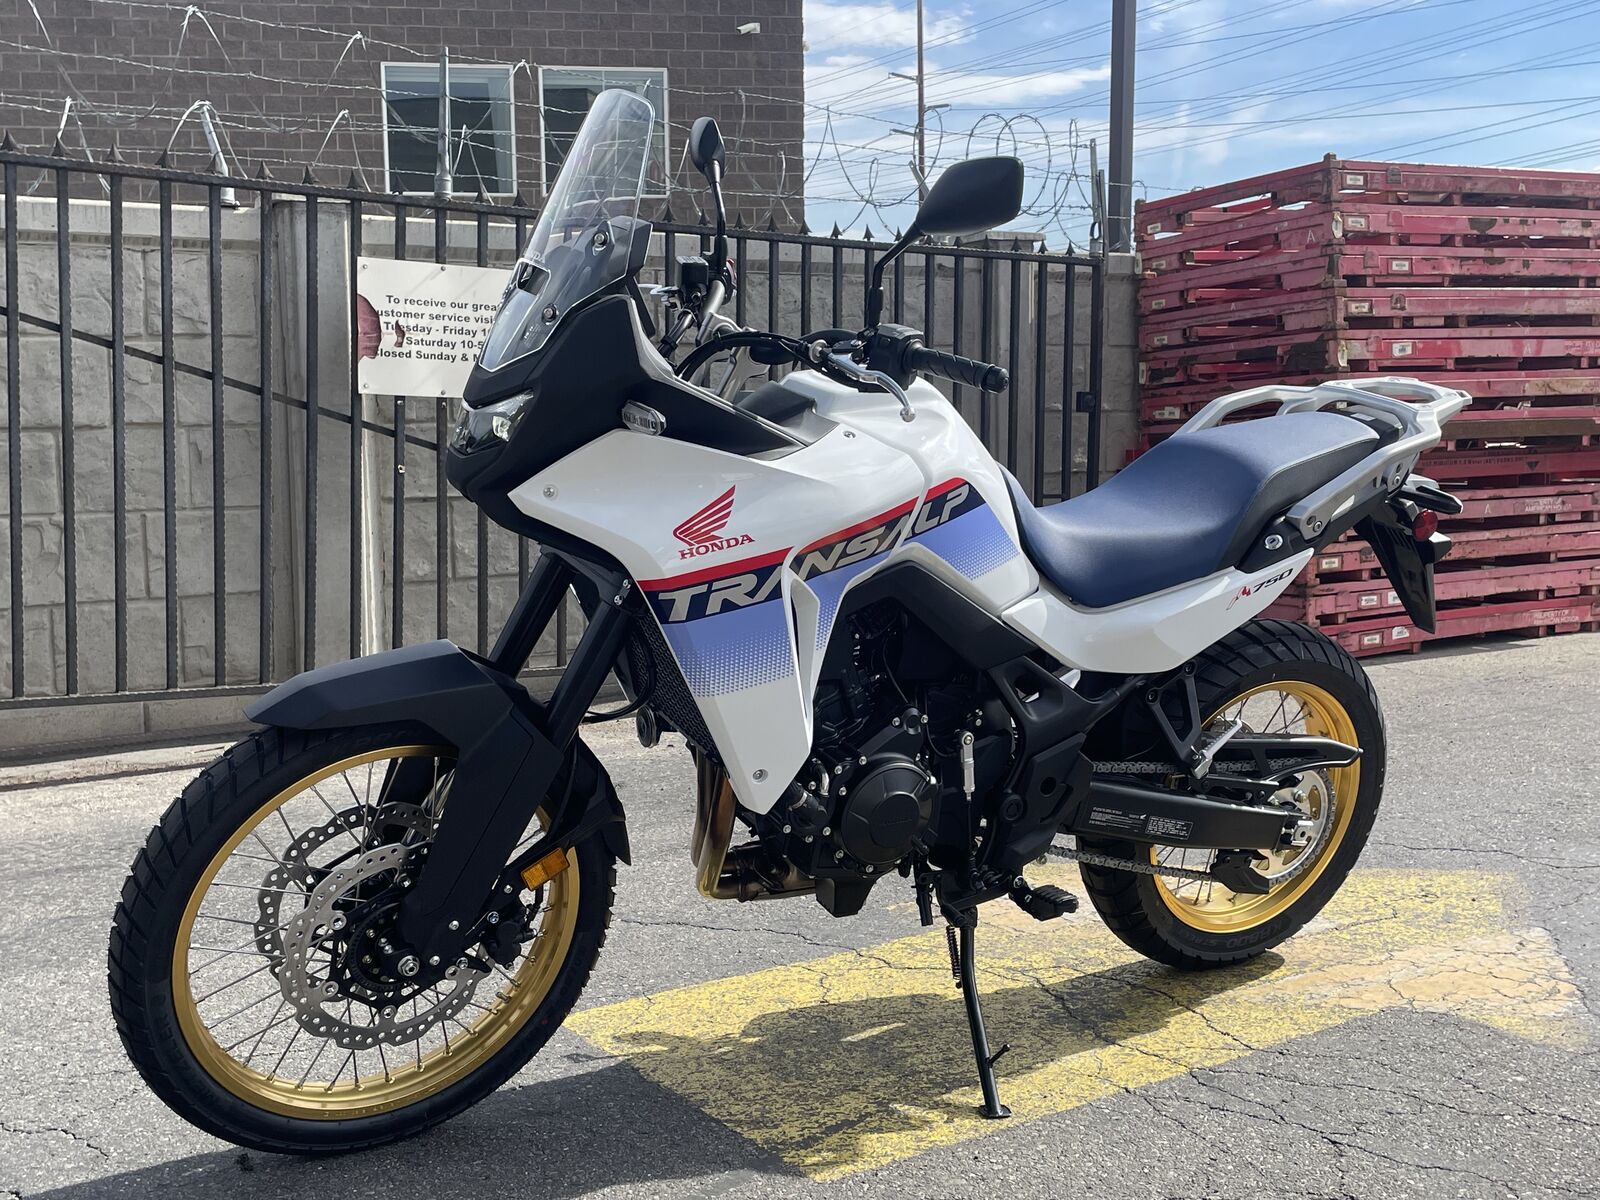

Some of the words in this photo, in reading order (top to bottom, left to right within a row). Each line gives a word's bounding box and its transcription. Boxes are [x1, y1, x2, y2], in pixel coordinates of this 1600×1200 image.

[385, 294, 400, 304] To
[404, 297, 447, 308] receive
[450, 301, 469, 309] our
[376, 309, 425, 319] ustomer
[428, 313, 470, 323] service
[474, 314, 496, 324] visi
[443, 325, 477, 338] Friday
[405, 336, 457, 350] Saturday
[377, 348, 412, 358] losed
[415, 350, 457, 363] Sunday
[460, 353, 469, 362] &
[678, 534, 756, 560] HONDA
[1253, 567, 1294, 594] 750
